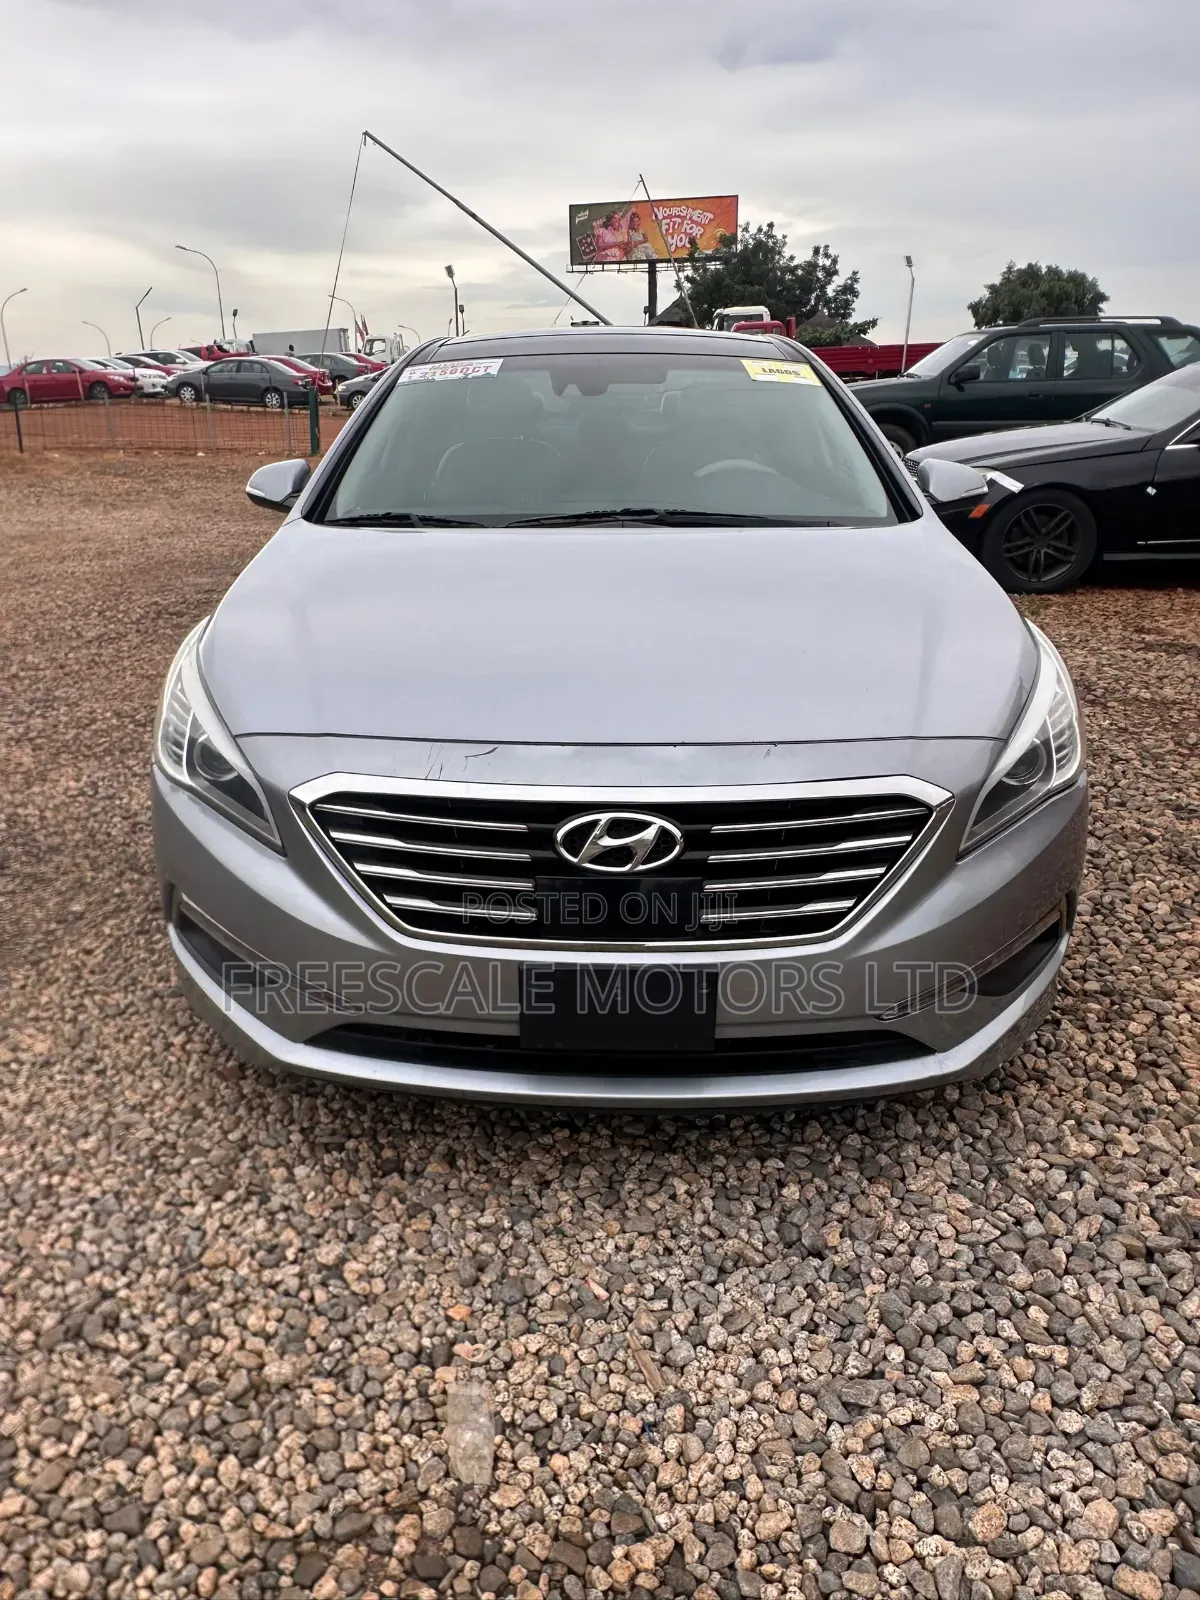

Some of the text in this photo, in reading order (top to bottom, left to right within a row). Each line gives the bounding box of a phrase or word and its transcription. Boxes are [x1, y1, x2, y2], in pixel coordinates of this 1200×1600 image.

[652, 205, 715, 225] NOURISHMENT
[661, 217, 704, 239] FIT FOR
